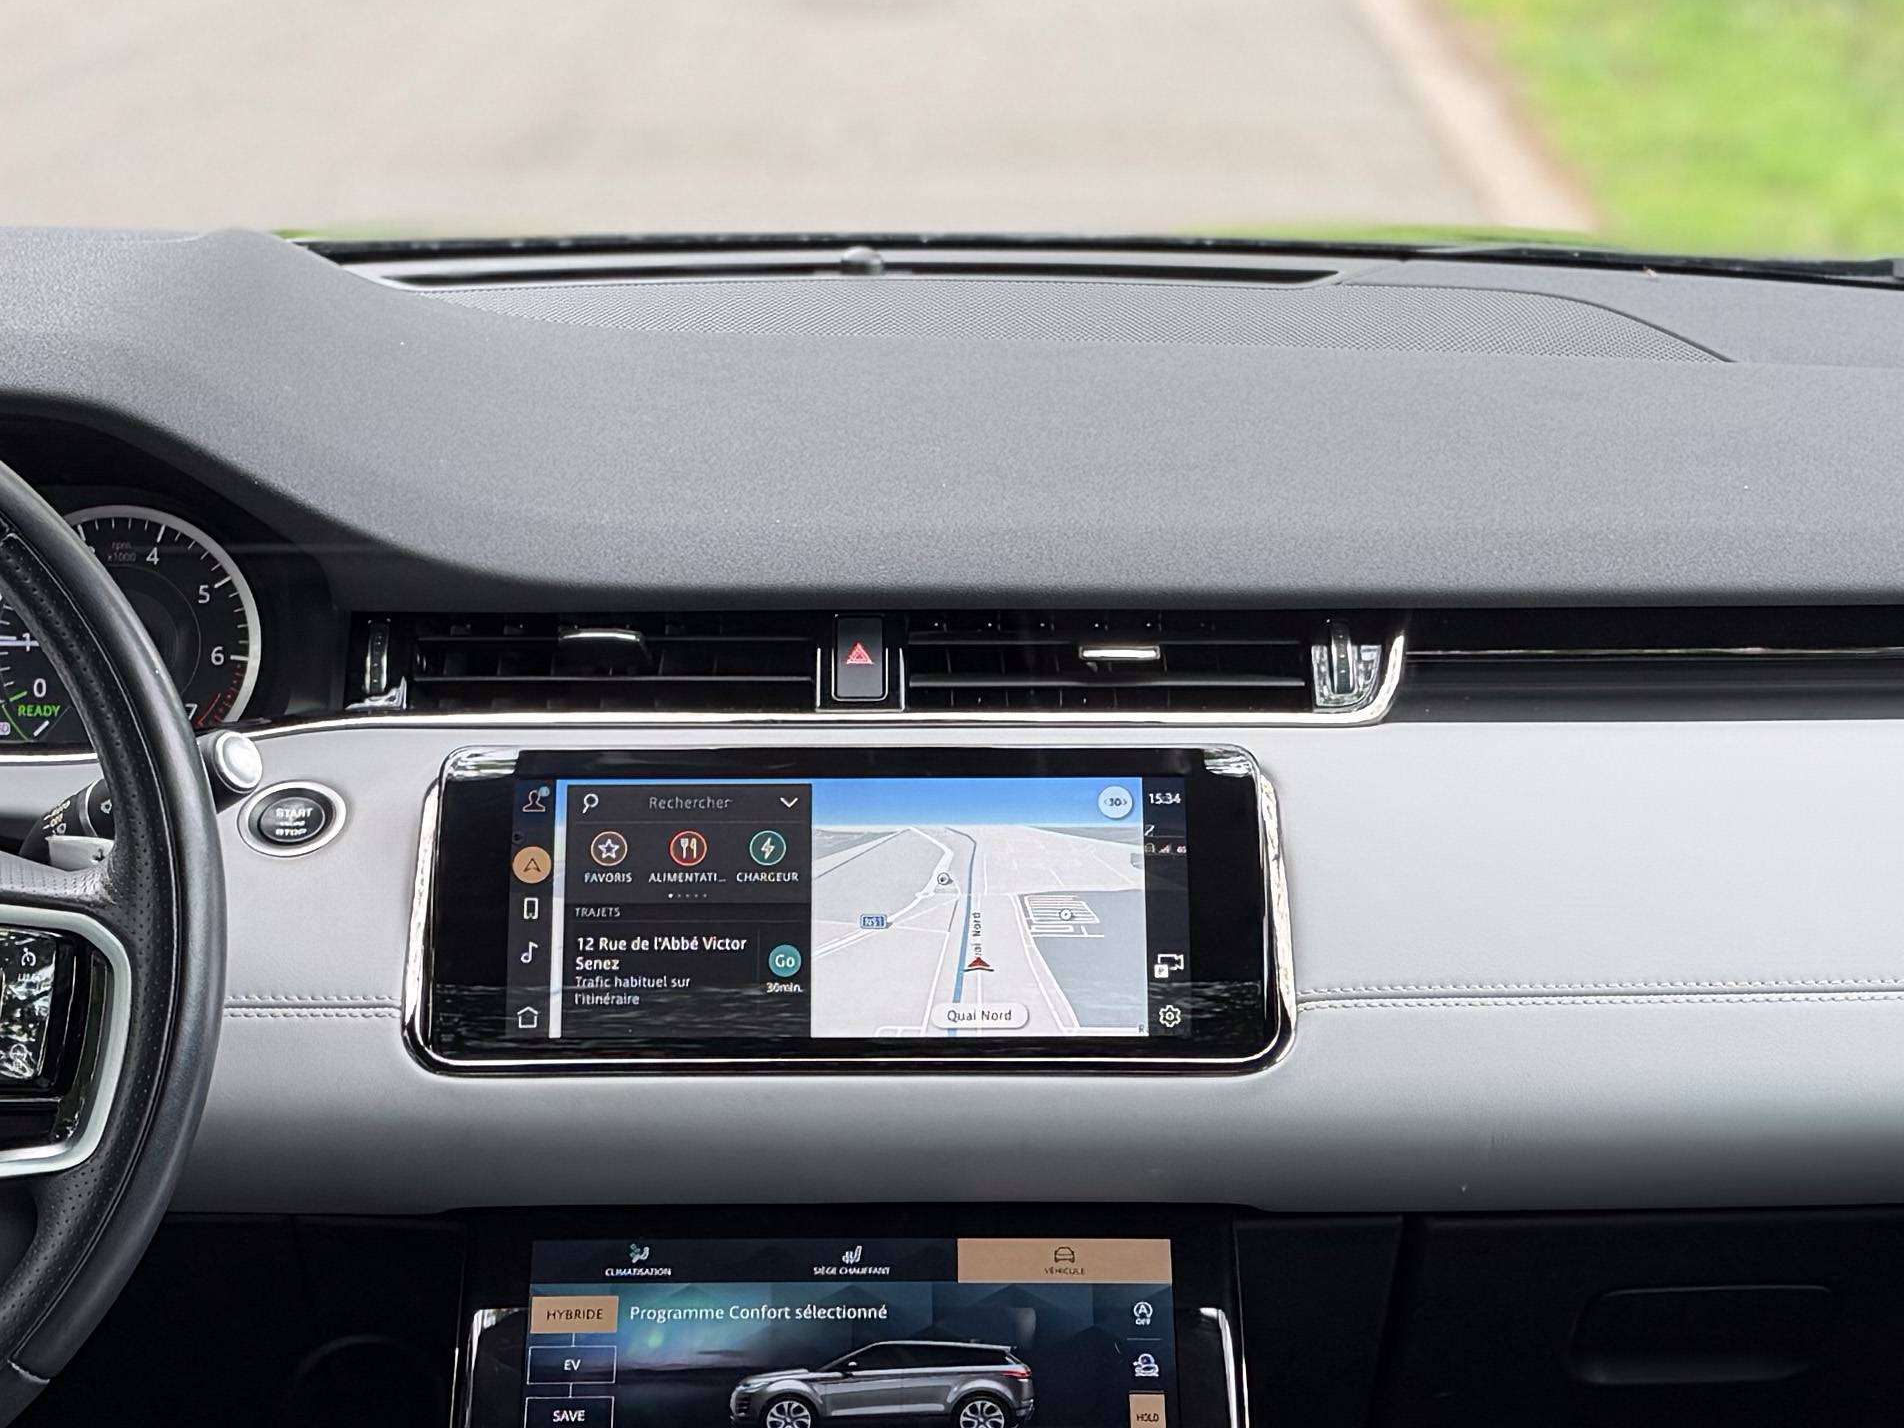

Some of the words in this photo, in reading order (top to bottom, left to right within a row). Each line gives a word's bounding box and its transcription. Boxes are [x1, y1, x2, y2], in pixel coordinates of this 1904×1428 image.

[146, 547, 160, 566] 4
[198, 585, 211, 604] 5
[211, 646, 225, 666] 6
[33, 678, 47, 698] 0
[17, 704, 62, 718] READY
[649, 796, 733, 810] Rechercher
[584, 872, 633, 884] FAVORIS
[736, 872, 799, 883] CHARGEUR
[574, 907, 621, 918] TRAJETS
[577, 938, 594, 951] 12
[599, 938, 627, 951] Rue
[631, 936, 649, 951] de
[654, 936, 698, 951] l'Abbé
[703, 936, 747, 951] Victor
[575, 957, 620, 971] Senez
[775, 954, 795, 968] Go
[575, 976, 611, 988] Trafic
[614, 975, 668, 988] habituel
[671, 978, 691, 988] sur
[947, 1010, 976, 1022] Quai
[981, 1009, 1012, 1022] Nord
[546, 1308, 603, 1322] HYBRIDE
[630, 1306, 724, 1324] Programme
[729, 1305, 790, 1320] Confort
[795, 1303, 887, 1320] sélectionné
[564, 1359, 581, 1371] EV
[552, 1409, 585, 1423] SAVE
[1136, 1412, 1159, 1423] HOLD
